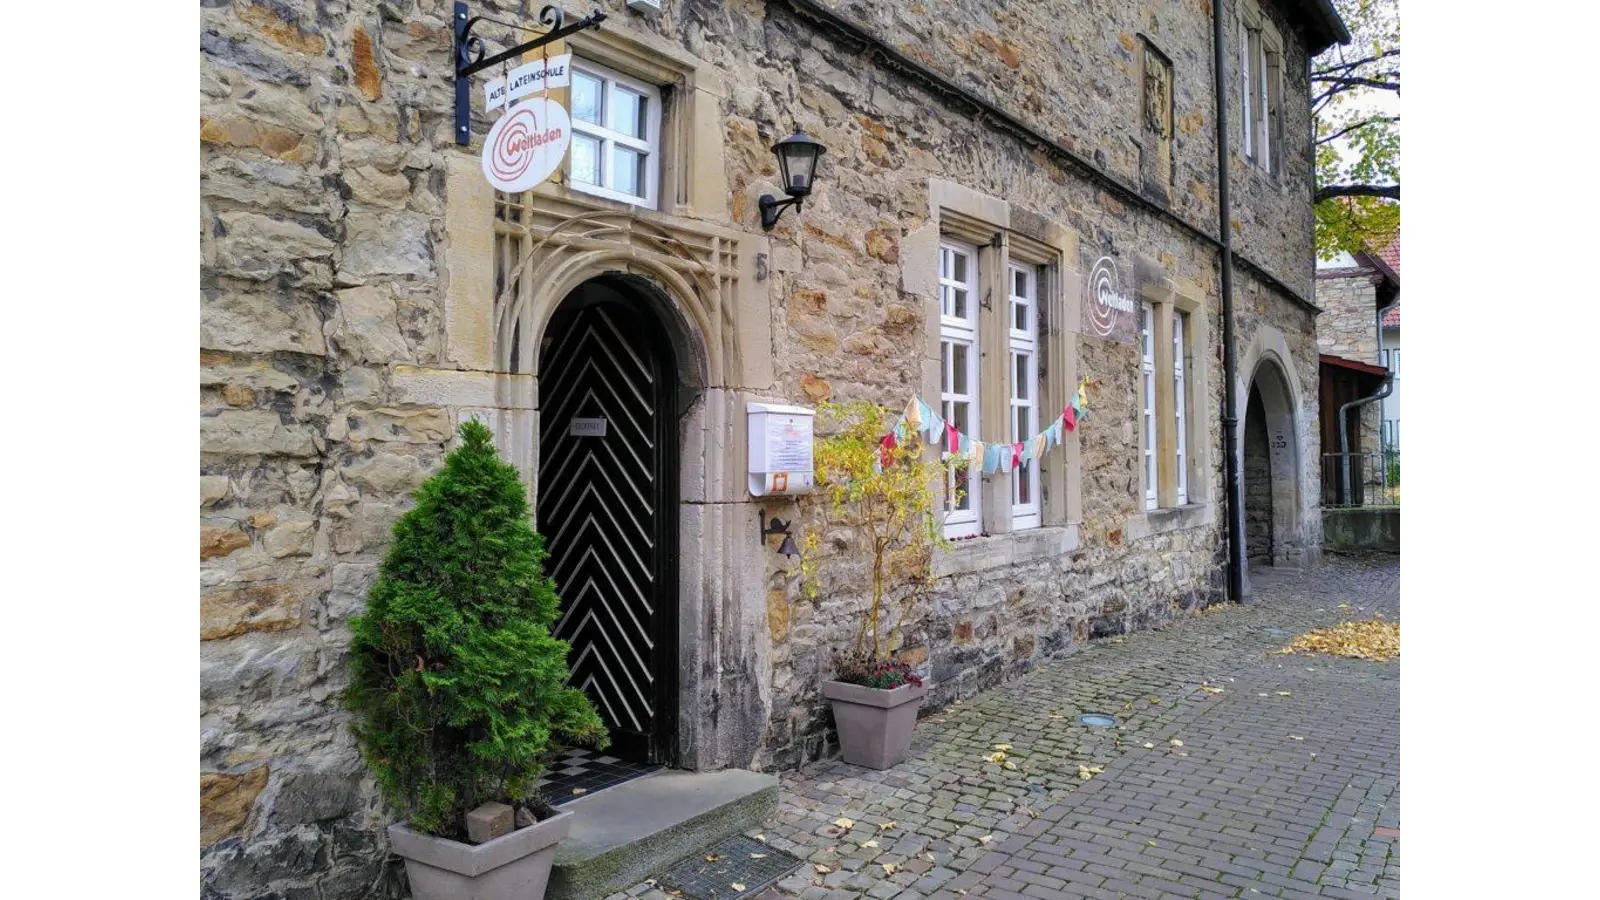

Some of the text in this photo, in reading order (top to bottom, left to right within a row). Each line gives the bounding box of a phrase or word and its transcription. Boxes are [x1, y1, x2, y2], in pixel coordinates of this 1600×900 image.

[489, 65, 564, 102] ALTE LATEINSCHULE
[507, 128, 562, 156] Weltladen
[756, 252, 768, 281] 5
[1099, 289, 1134, 313] Weltladen
